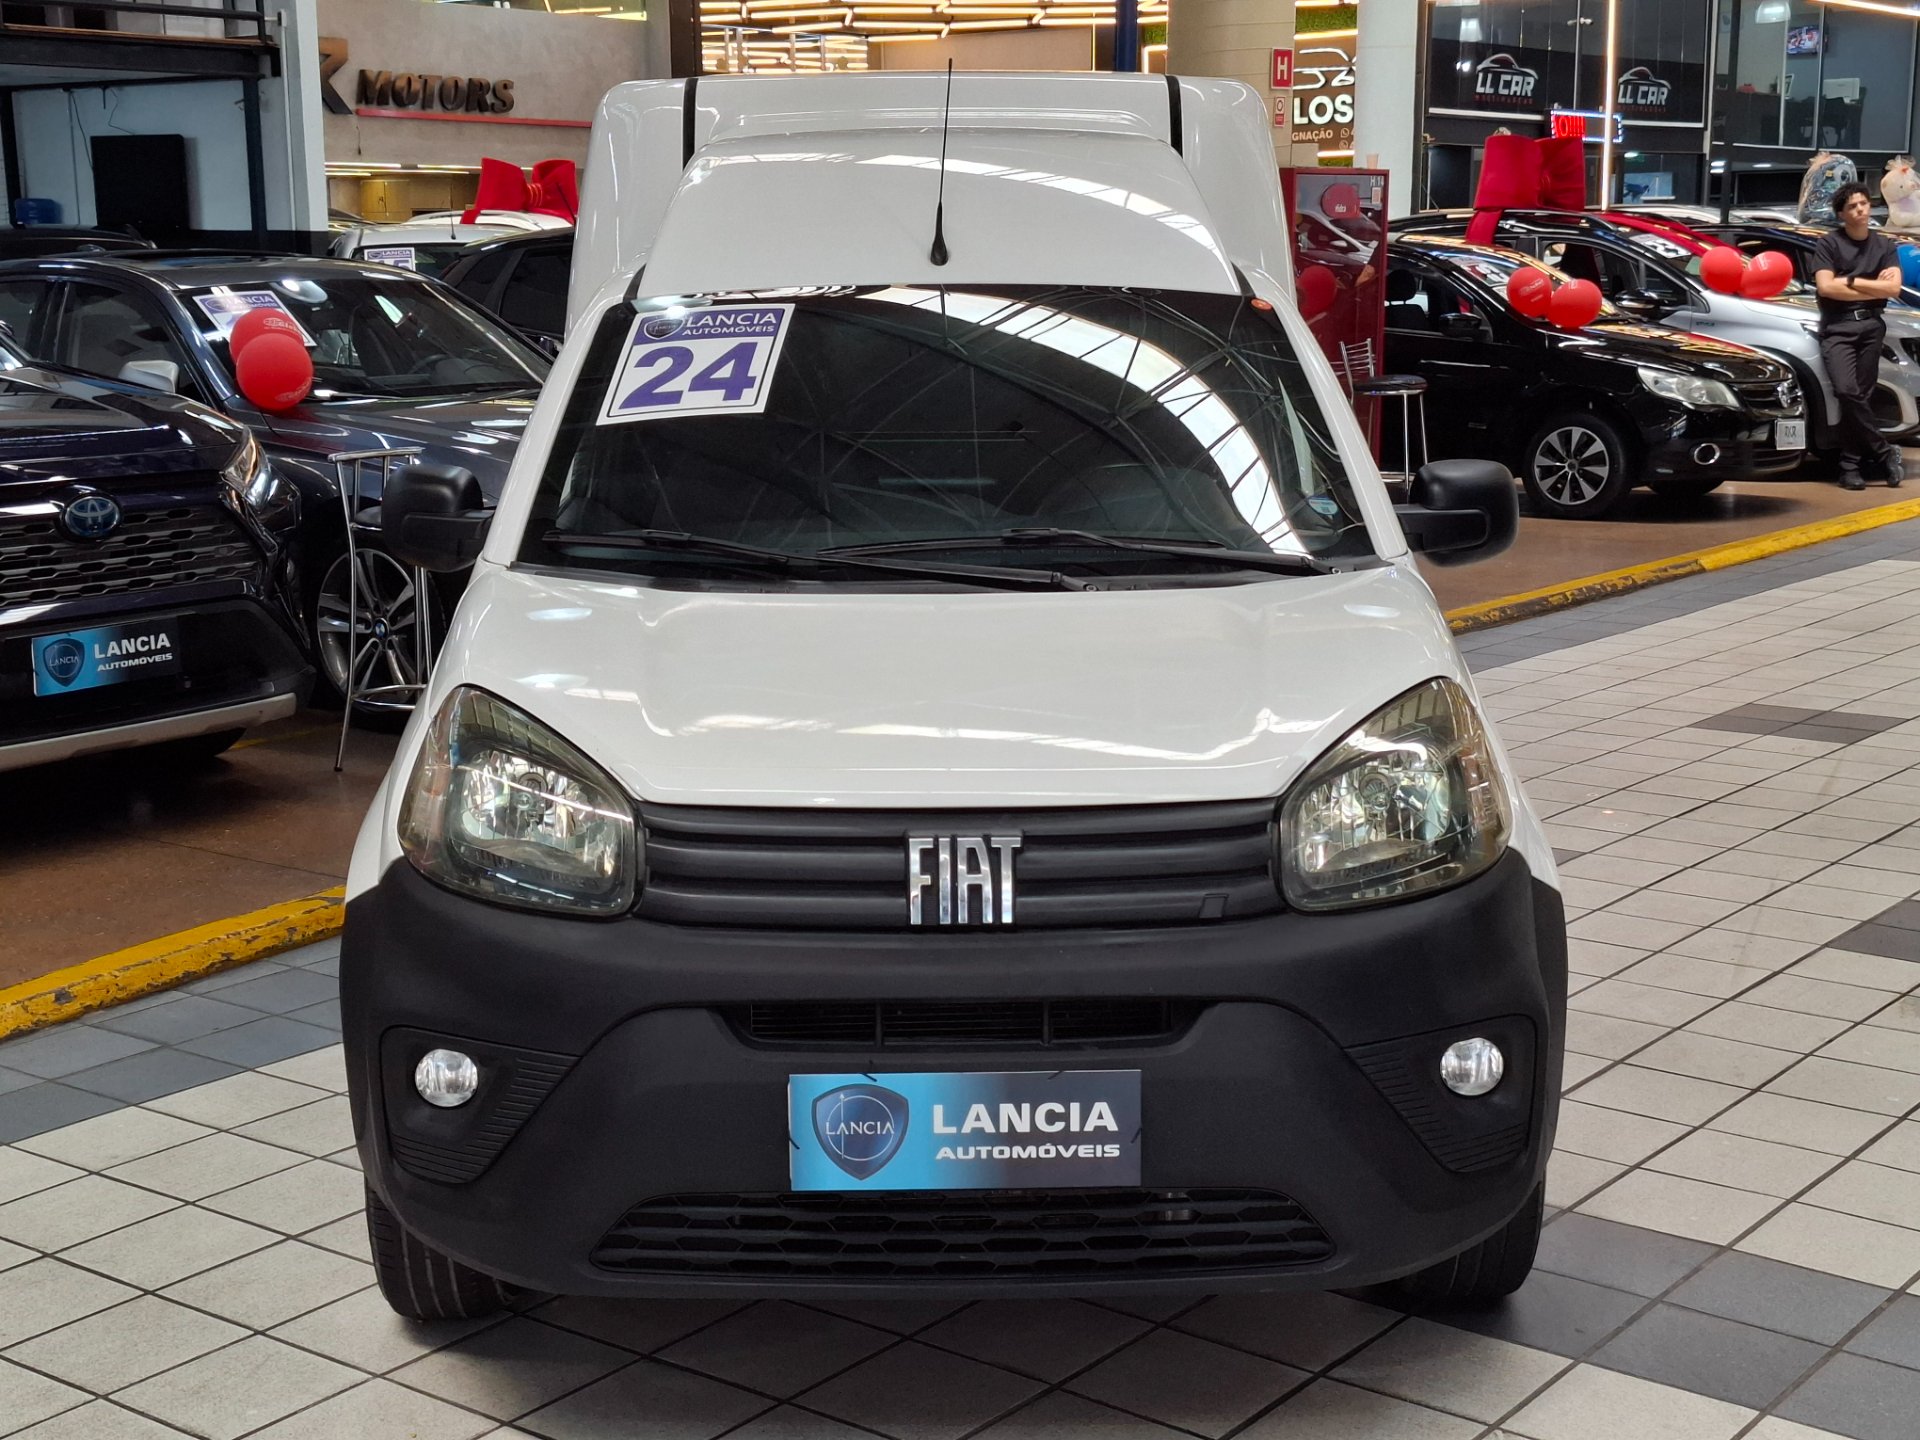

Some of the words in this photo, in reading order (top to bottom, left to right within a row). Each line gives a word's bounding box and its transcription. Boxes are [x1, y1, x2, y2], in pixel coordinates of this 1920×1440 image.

[1277, 56, 1288, 81] H
[356, 69, 515, 114] MOTORS
[1475, 72, 1495, 94] LL
[1498, 73, 1535, 97] CAR
[1617, 84, 1634, 104] LL
[1637, 85, 1668, 105] CAR
[1293, 94, 1354, 125] LOS
[382, 249, 411, 257] LANCIA
[682, 325, 775, 336] AUTOMÓVEIS
[686, 312, 777, 328] LANCIA
[618, 342, 759, 410] 24
[94, 632, 171, 659] LANCIA
[48, 655, 80, 667] LANCIA
[909, 837, 1022, 925] FIAT
[825, 1120, 895, 1136] LANCIA
[932, 1101, 1119, 1134] LANCIA
[935, 1142, 1121, 1160] AUTOMÓVEIS
